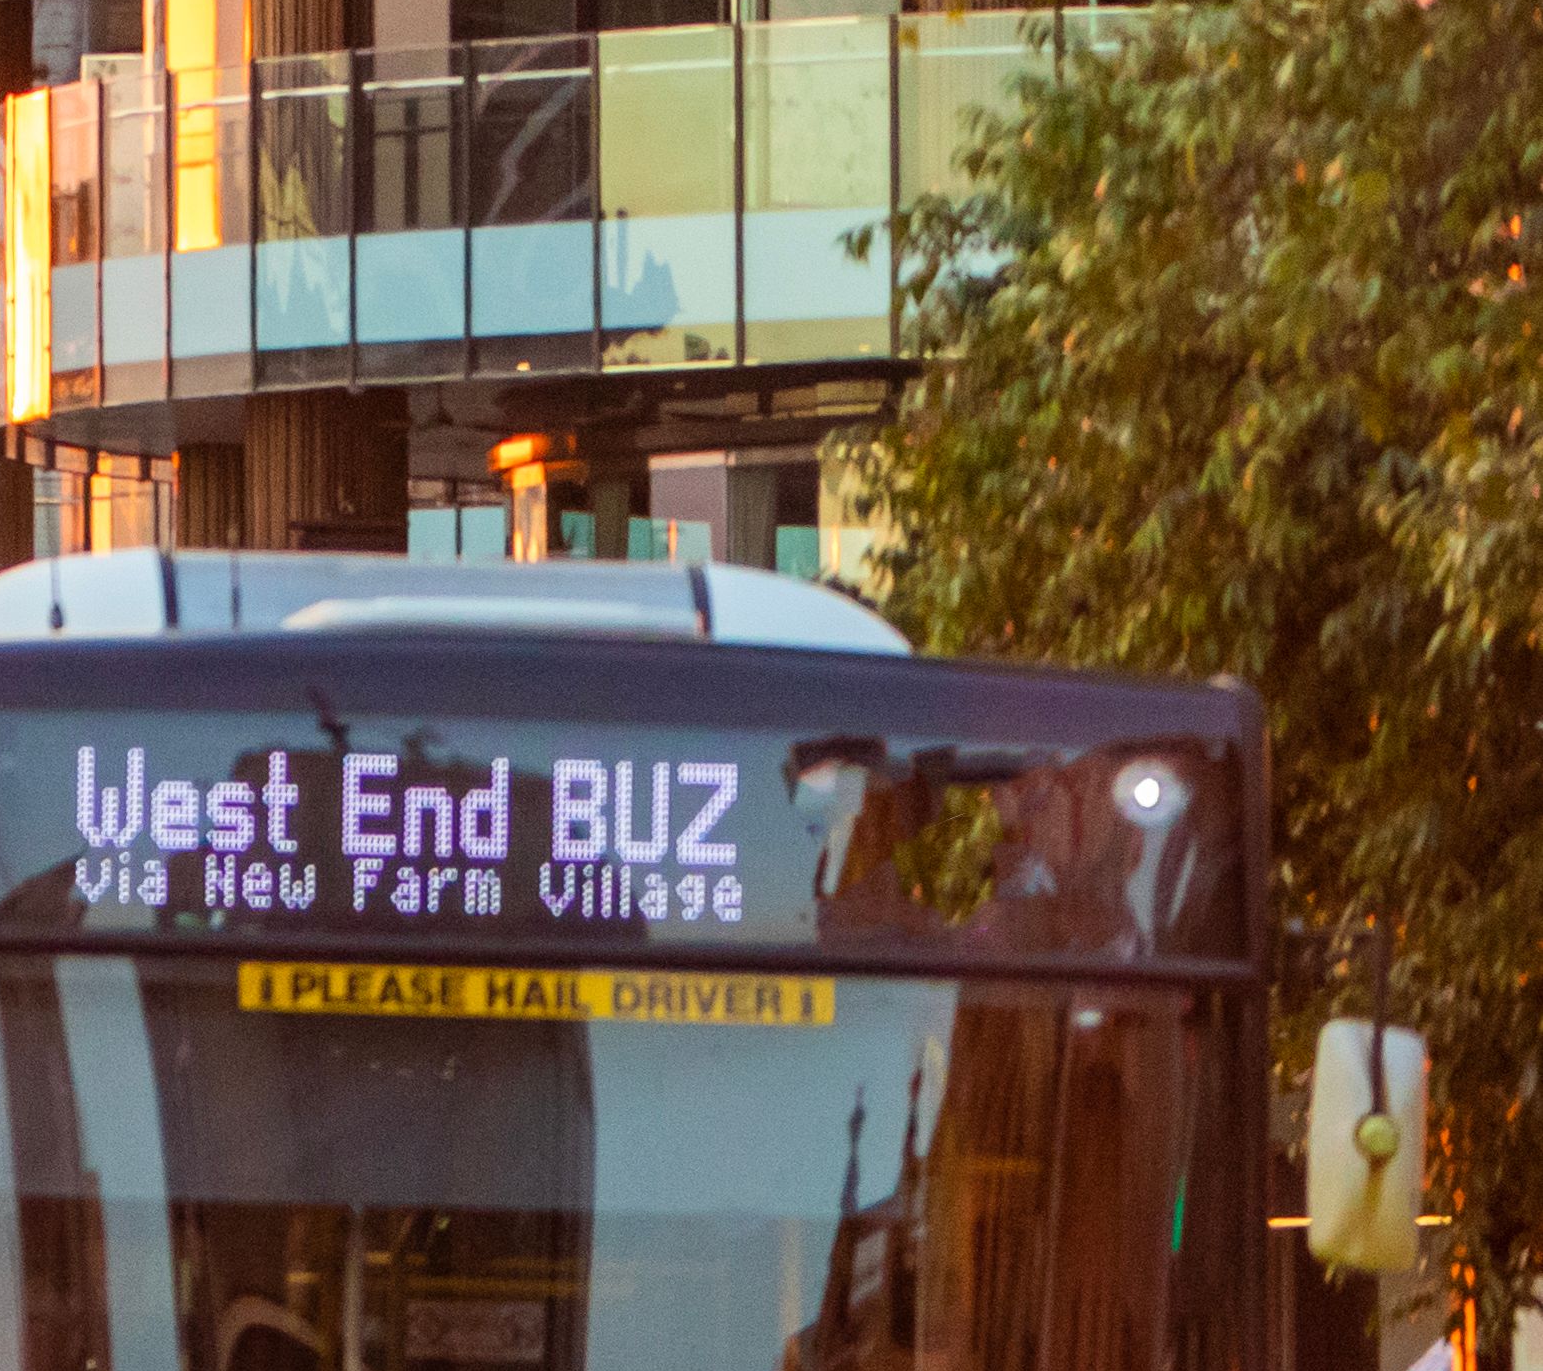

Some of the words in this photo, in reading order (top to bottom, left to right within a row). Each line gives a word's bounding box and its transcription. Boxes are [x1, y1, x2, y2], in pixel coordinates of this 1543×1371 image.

[78, 746, 298, 853] West
[342, 754, 510, 859] End
[552, 759, 738, 866] BUZ
[75, 852, 167, 905] via
[205, 854, 317, 909] New
[353, 857, 502, 915] Farm
[539, 862, 743, 922] Village
[290, 970, 456, 1010] PLEASE
[486, 972, 587, 1012] HAIL
[611, 975, 782, 1018] DRIVER
